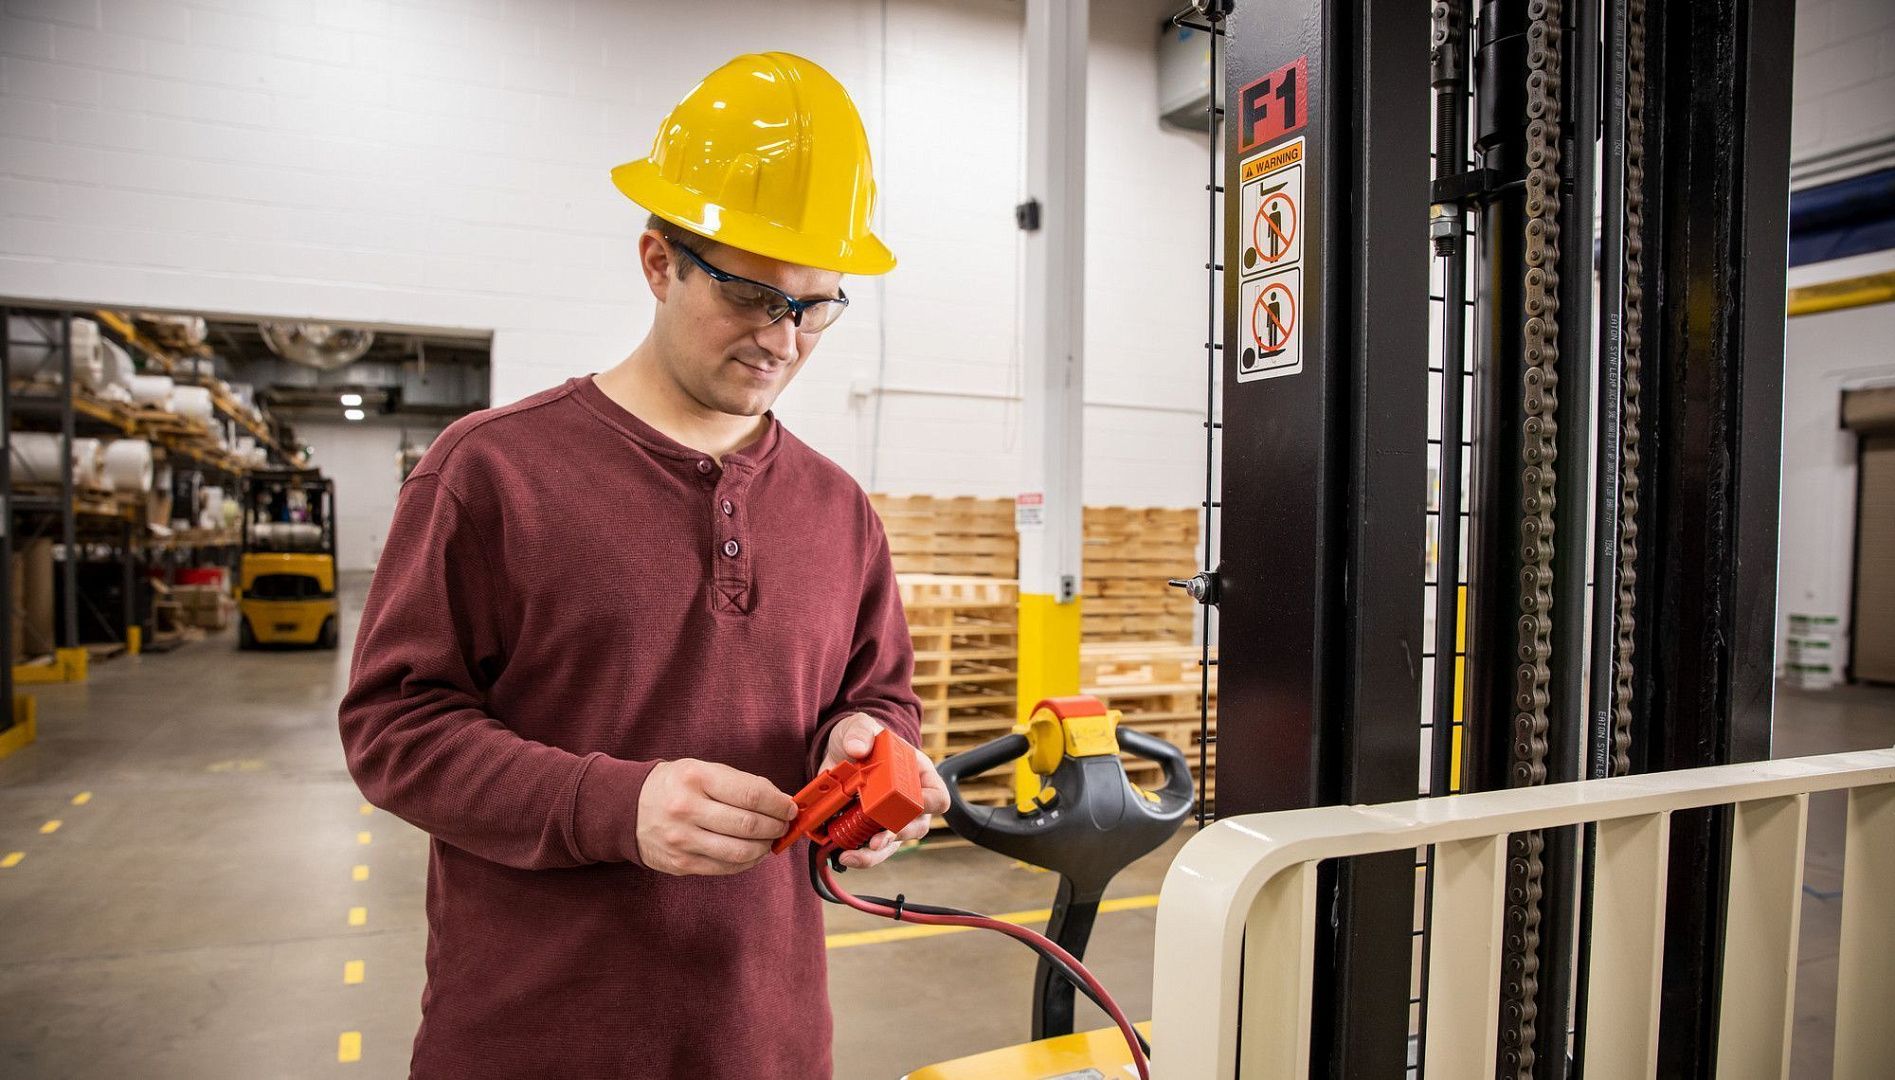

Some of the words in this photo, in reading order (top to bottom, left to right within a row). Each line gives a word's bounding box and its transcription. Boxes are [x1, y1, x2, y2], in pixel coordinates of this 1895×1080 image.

[1242, 67, 1296, 148] F1
[1256, 148, 1299, 173] WARNING
[1610, 313, 1619, 341] EATON
[1598, 710, 1607, 738] EATON
